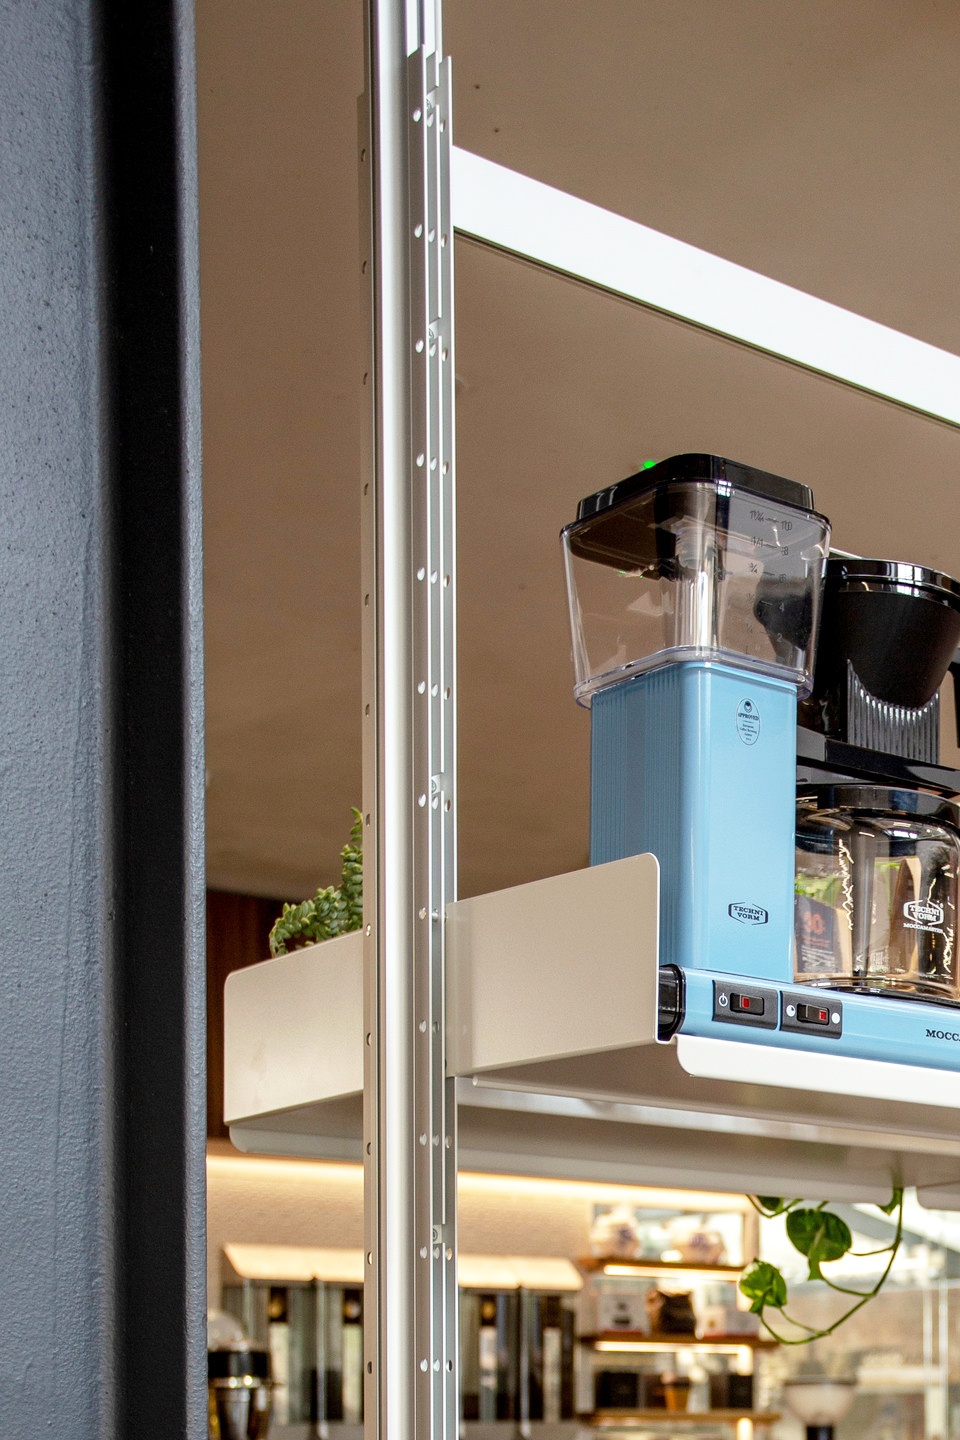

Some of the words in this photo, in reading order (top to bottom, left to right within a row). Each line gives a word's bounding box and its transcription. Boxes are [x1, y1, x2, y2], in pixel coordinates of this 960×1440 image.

[733, 905, 764, 917] TECHNI
[909, 904, 940, 916] TECHNI
[737, 912, 761, 922] VORM
[912, 911, 937, 922] VORM
